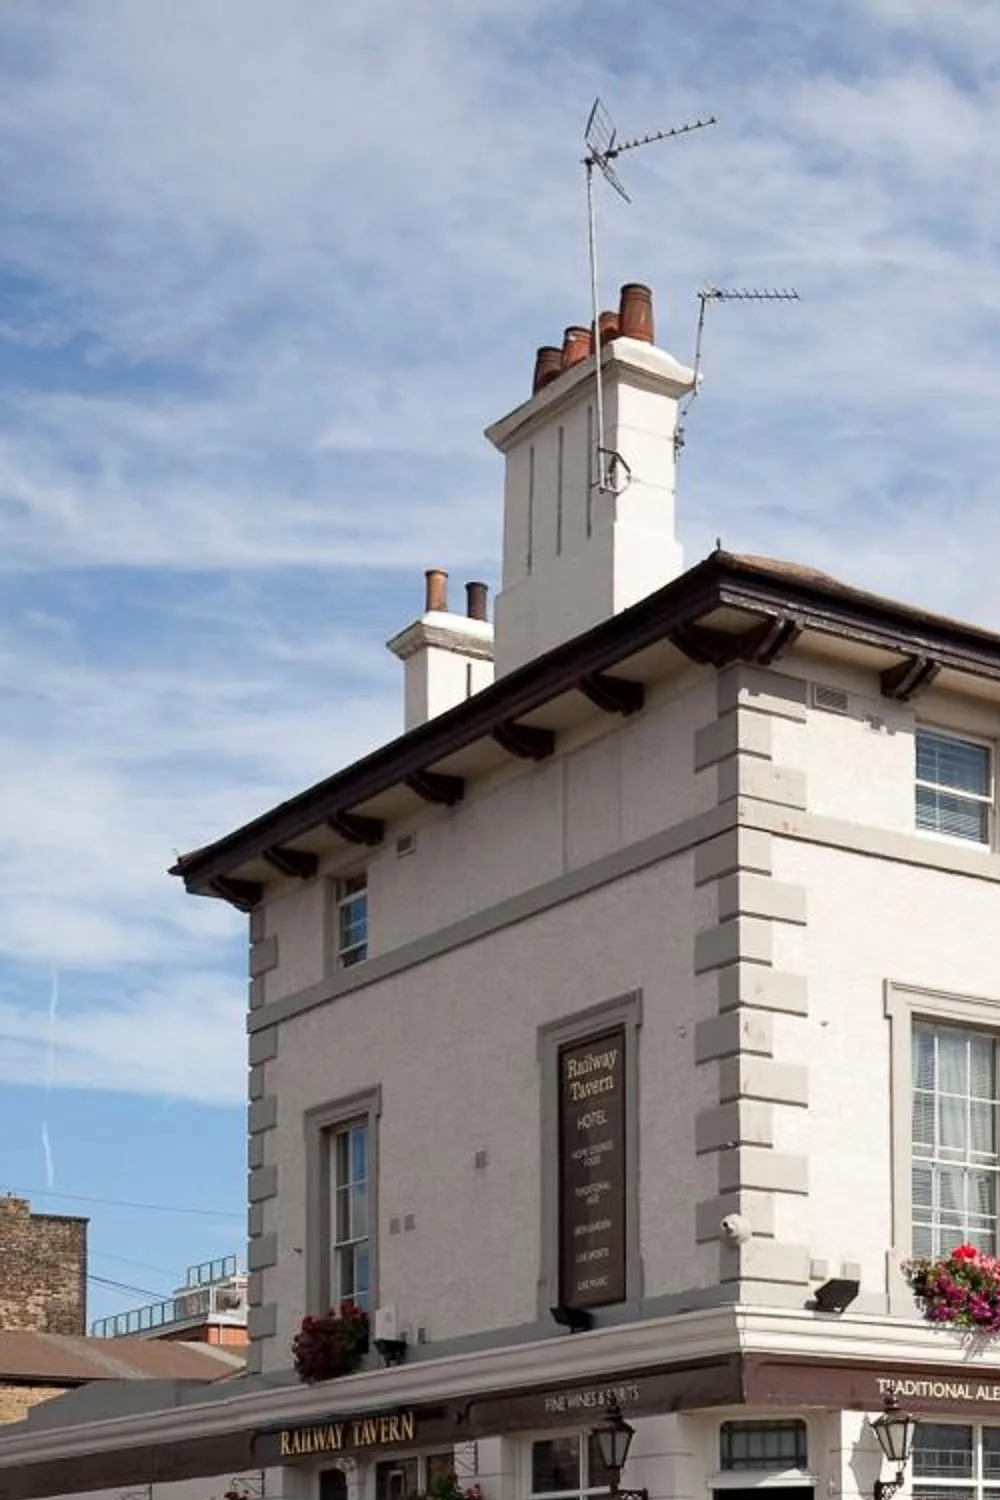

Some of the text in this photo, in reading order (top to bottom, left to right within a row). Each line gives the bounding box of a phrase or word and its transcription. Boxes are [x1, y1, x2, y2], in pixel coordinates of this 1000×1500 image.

[567, 1049, 617, 1079] Railway
[570, 1075, 614, 1100] Tavern
[577, 1109, 607, 1131] HOTEL
[607, 1384, 639, 1404] SRITS
[280, 1411, 414, 1456] RAILWAY TAVERN
